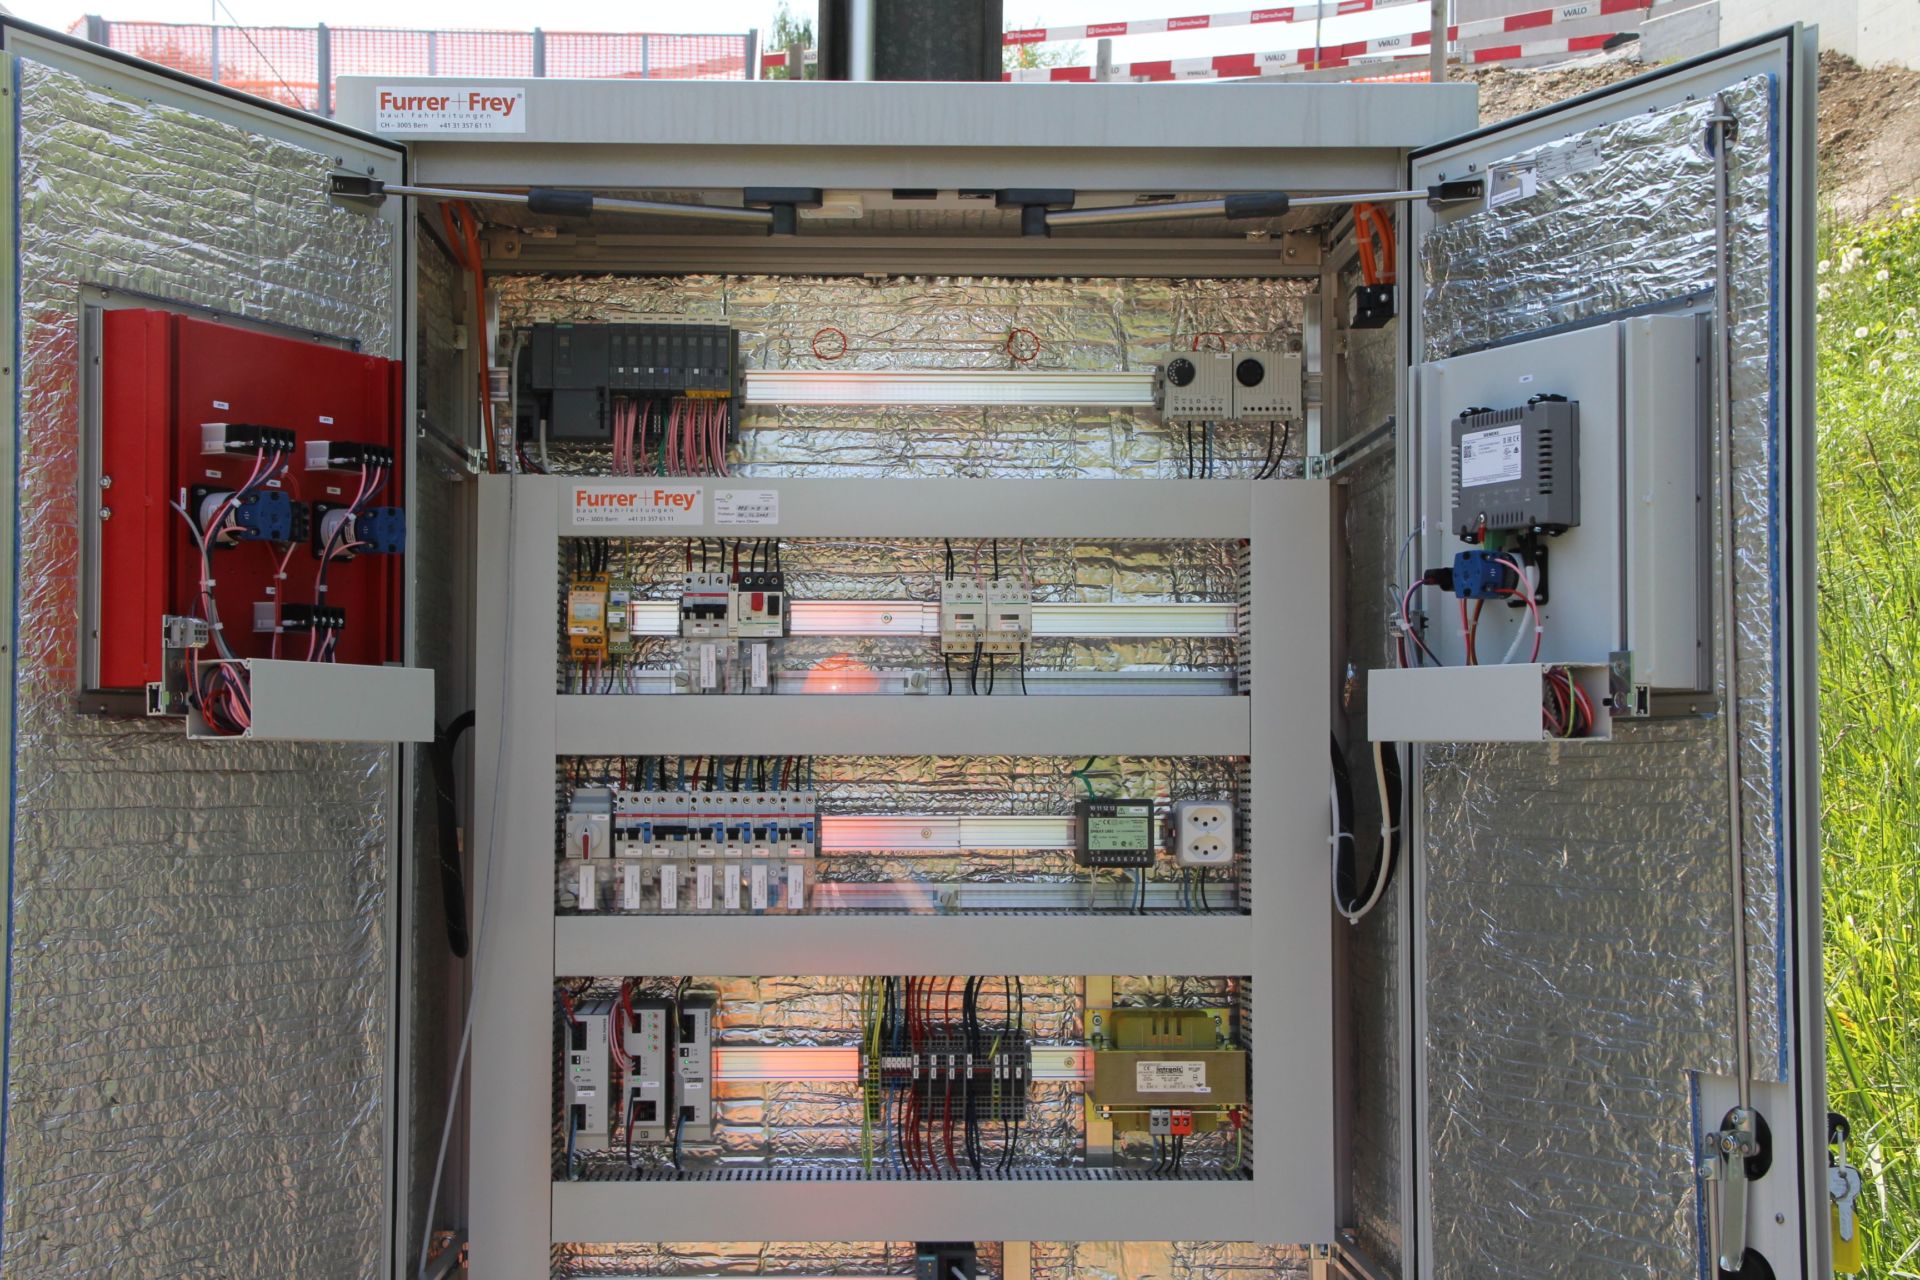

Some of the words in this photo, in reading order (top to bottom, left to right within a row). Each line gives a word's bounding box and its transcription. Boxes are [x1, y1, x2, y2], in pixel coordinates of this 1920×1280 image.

[1563, 6, 1587, 17] WALO
[1378, 39, 1400, 48] WALO
[1265, 53, 1286, 62] WALO
